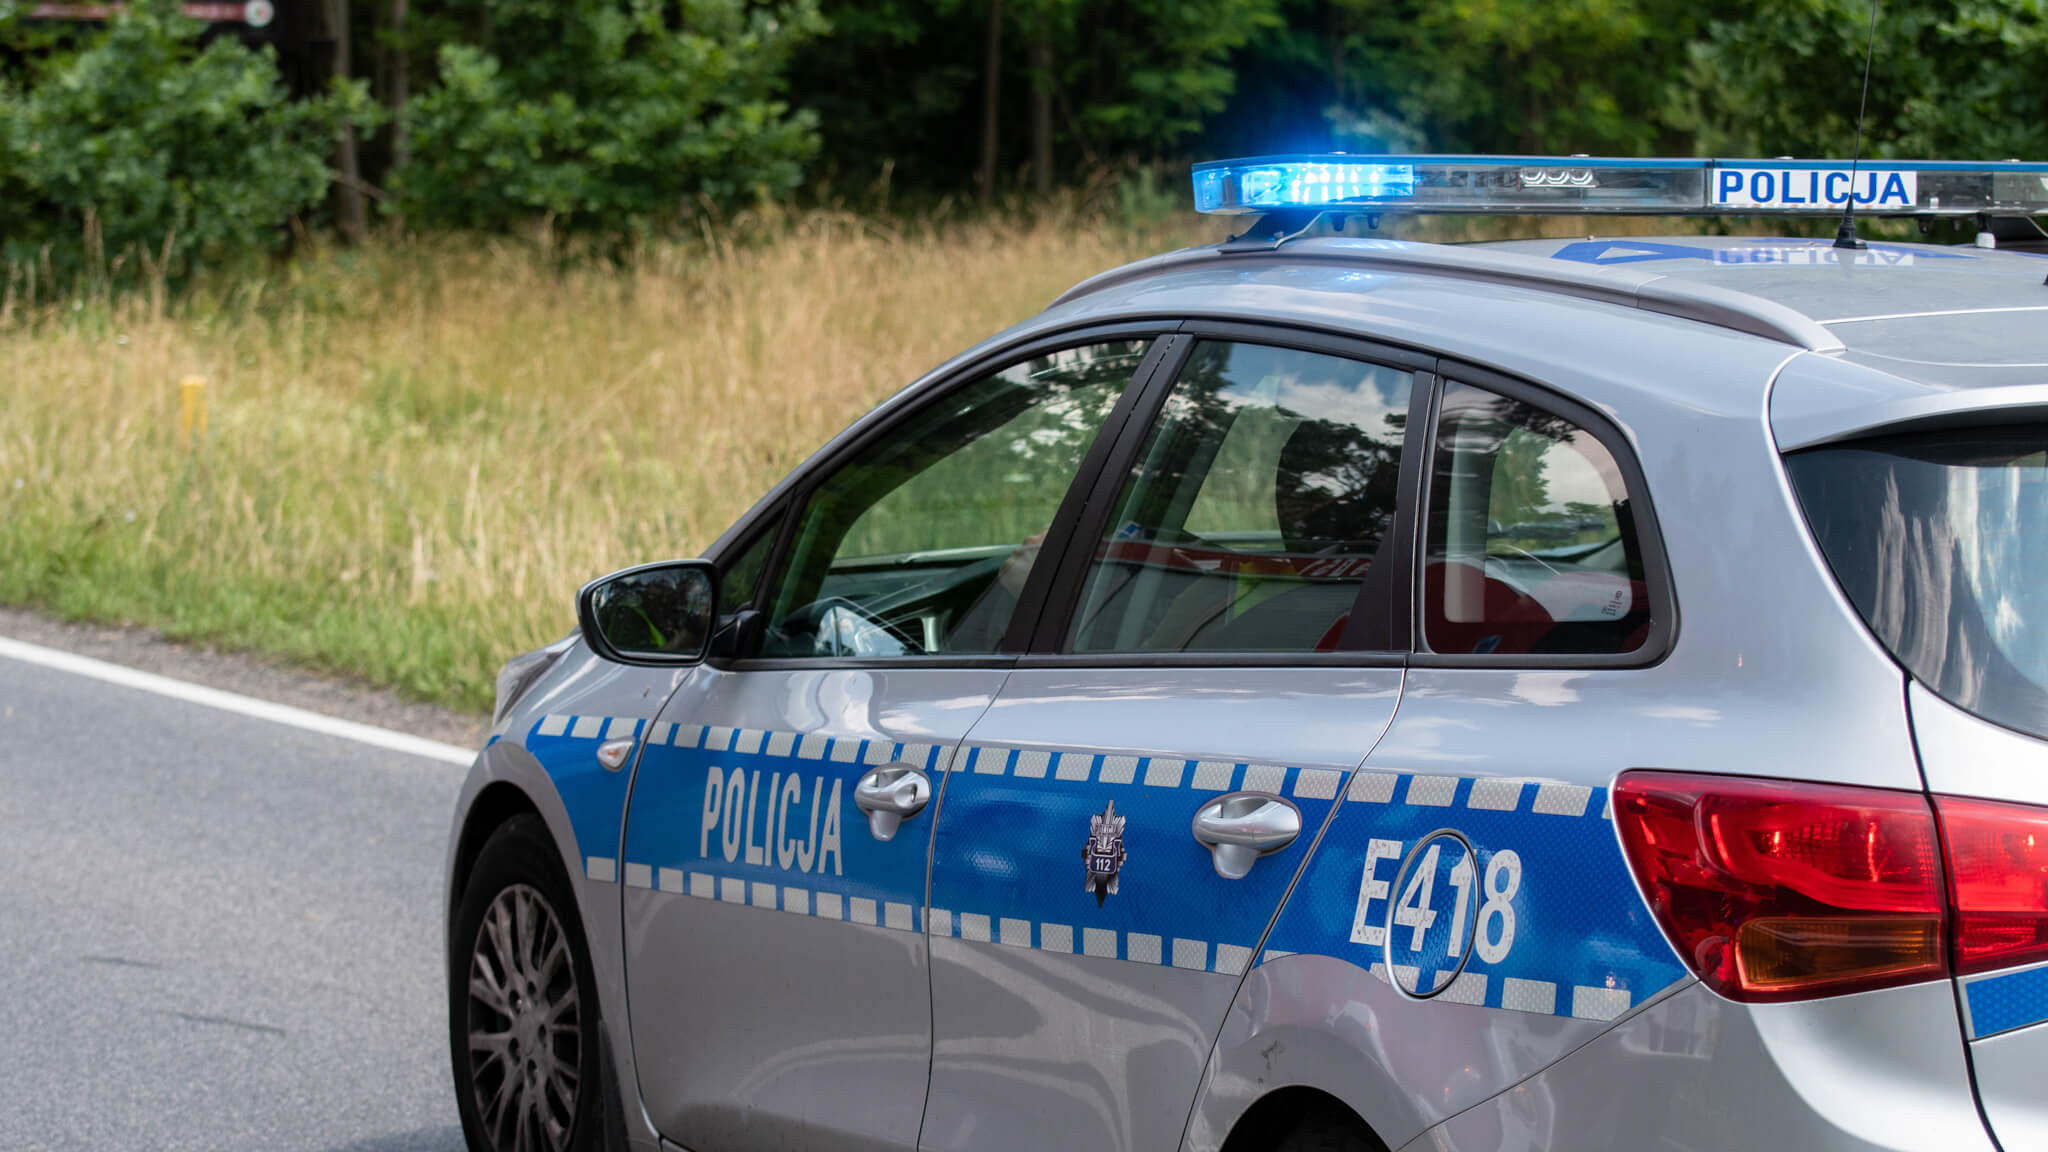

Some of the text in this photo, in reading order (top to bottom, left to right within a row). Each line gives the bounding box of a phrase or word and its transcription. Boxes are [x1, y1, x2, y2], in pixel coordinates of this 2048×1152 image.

[1719, 170, 1910, 204] POLICJA
[700, 766, 843, 876] POLICJA
[1095, 858, 1111, 872] 112
[1349, 838, 1522, 965] E418
